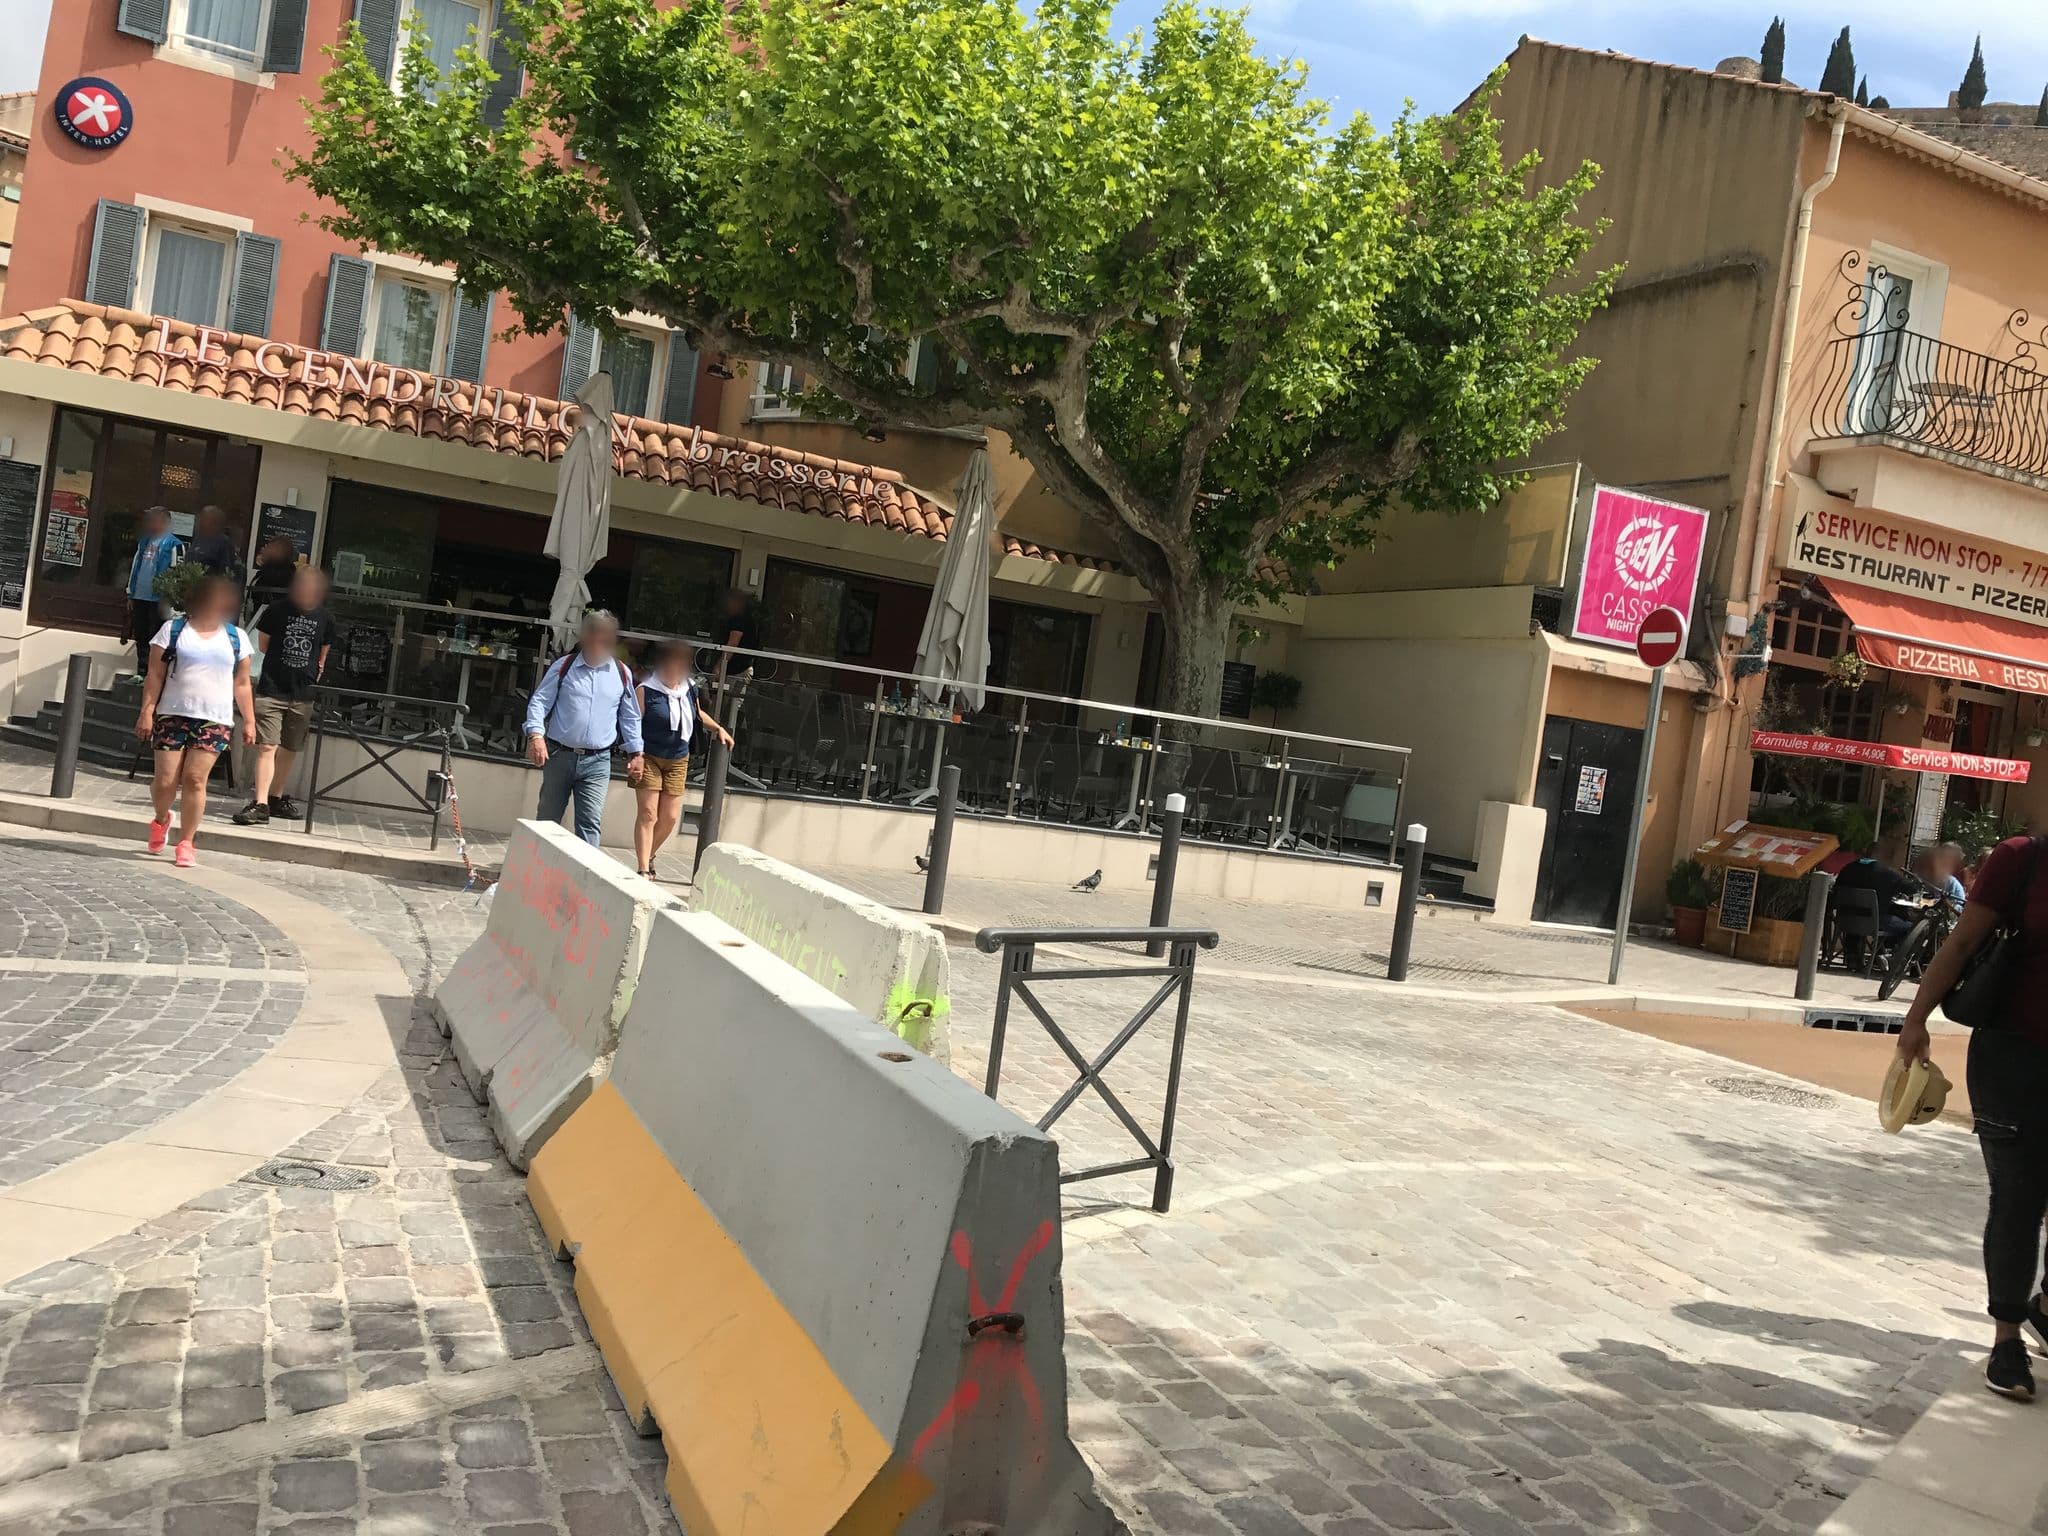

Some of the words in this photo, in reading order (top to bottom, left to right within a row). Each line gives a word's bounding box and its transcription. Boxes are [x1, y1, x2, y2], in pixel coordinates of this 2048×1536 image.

[59, 114, 128, 146] INTER-HOTEL
[151, 316, 231, 368] LE
[254, 340, 638, 449] CENDRILLON
[687, 425, 894, 501] brasserie
[1628, 524, 1680, 580] BEN
[1815, 510, 1900, 553] SERVICE
[1903, 532, 1952, 565] NON
[1956, 544, 2002, 577] STOP
[1799, 542, 1951, 594] RESTAURANT
[1601, 592, 1660, 622] CASS
[1605, 617, 1635, 633] NIGHT
[1897, 646, 1981, 679] PIZZERIA
[2002, 664, 2048, 691] REST
[1755, 733, 1809, 750] Formules
[1902, 748, 1949, 769] Service
[1951, 753, 2017, 777] NON-STOP
